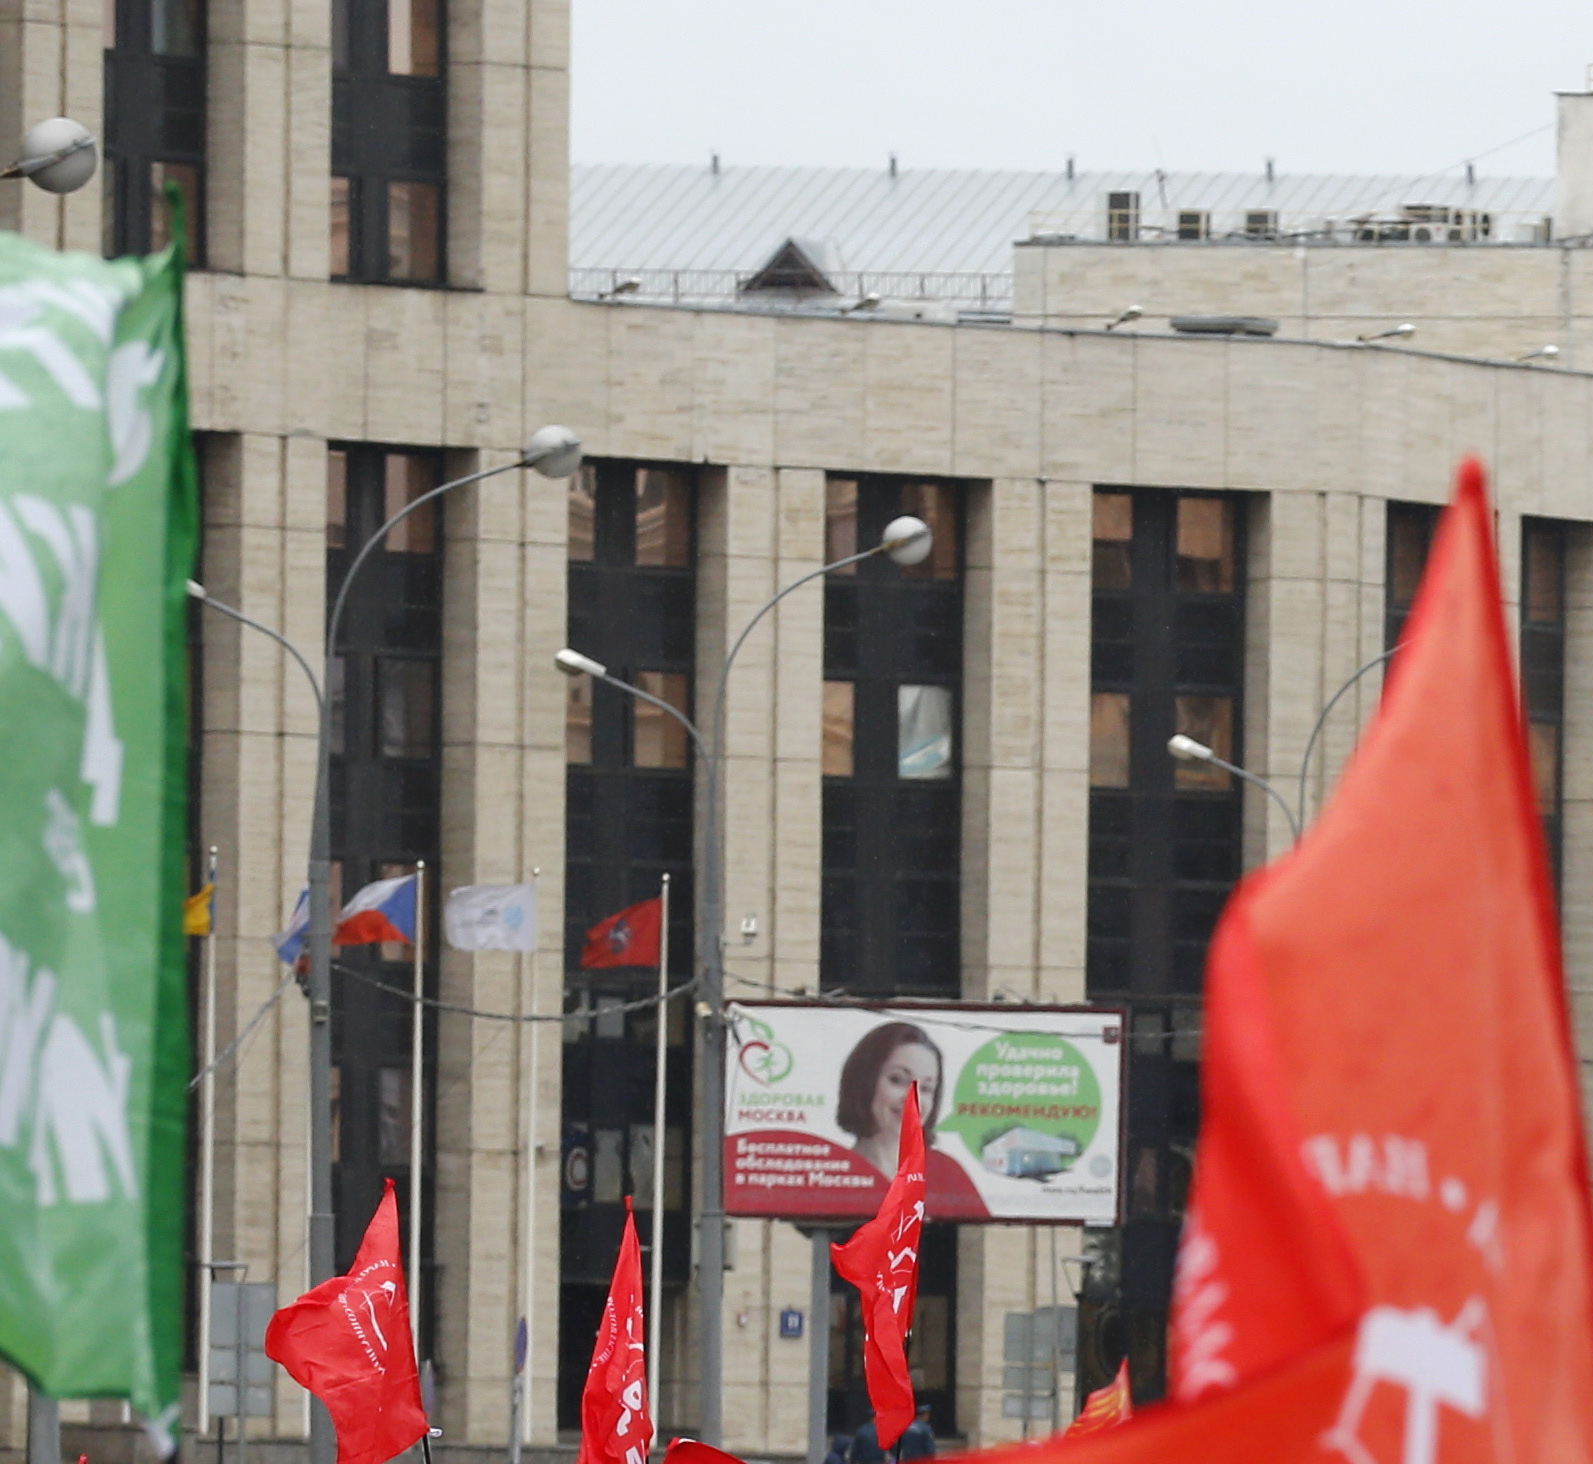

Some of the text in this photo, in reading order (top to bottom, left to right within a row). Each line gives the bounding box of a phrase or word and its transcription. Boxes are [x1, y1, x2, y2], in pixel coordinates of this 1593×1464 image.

[996, 1041, 1063, 1061] Удачно
[976, 1063, 1080, 1082] проверила
[977, 1079, 1078, 1098] здоровье!
[739, 1093, 825, 1108] ЗДОРОВАЯ
[738, 1109, 806, 1123] МОСКВА
[957, 1103, 1098, 1121] РЕКОМЕНДУЮ!
[736, 1138, 831, 1158] Бесплатное
[736, 1156, 851, 1174] обследование
[748, 1175, 804, 1191] парках
[807, 1172, 875, 1188] Москвы
